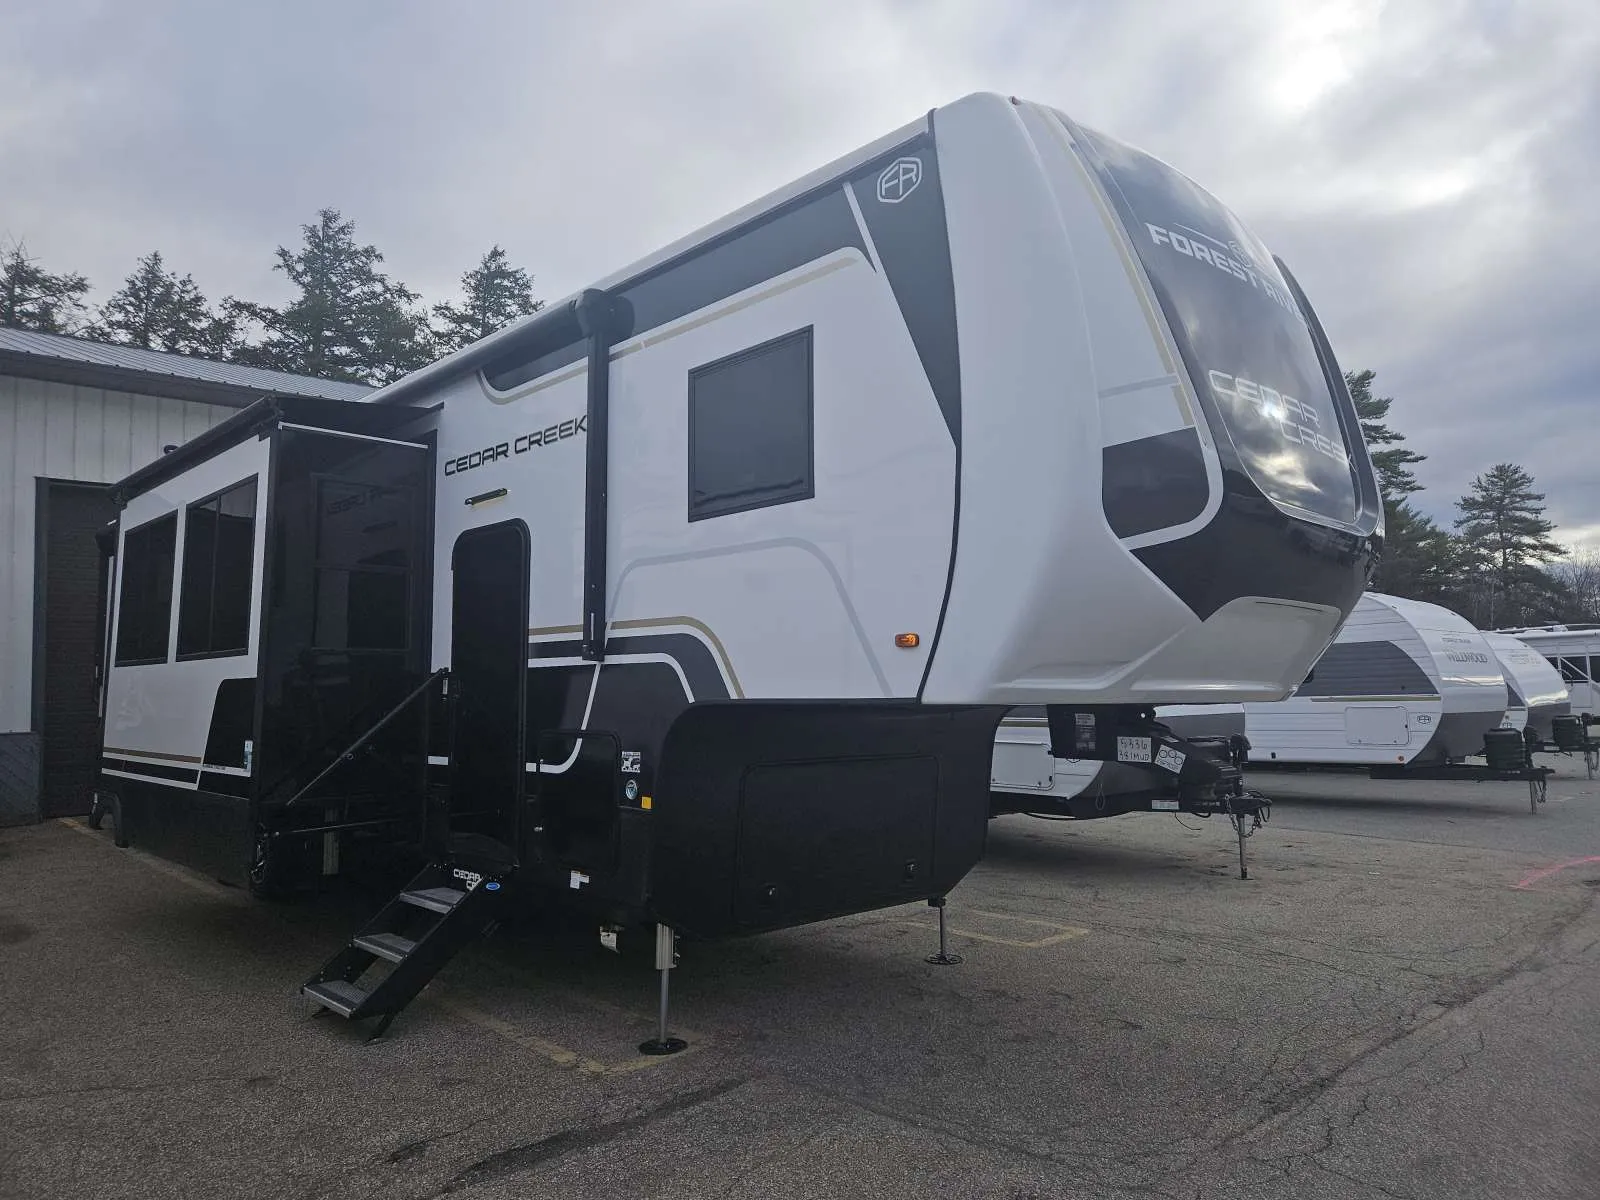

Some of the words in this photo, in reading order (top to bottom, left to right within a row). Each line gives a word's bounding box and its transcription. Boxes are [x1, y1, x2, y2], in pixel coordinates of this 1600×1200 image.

[1144, 222, 1258, 288] FOREST
[1208, 369, 1320, 428] CEDAR
[444, 442, 508, 476] CEDAR
[514, 414, 588, 454] CREEK
[453, 868, 481, 882] CEDAR
